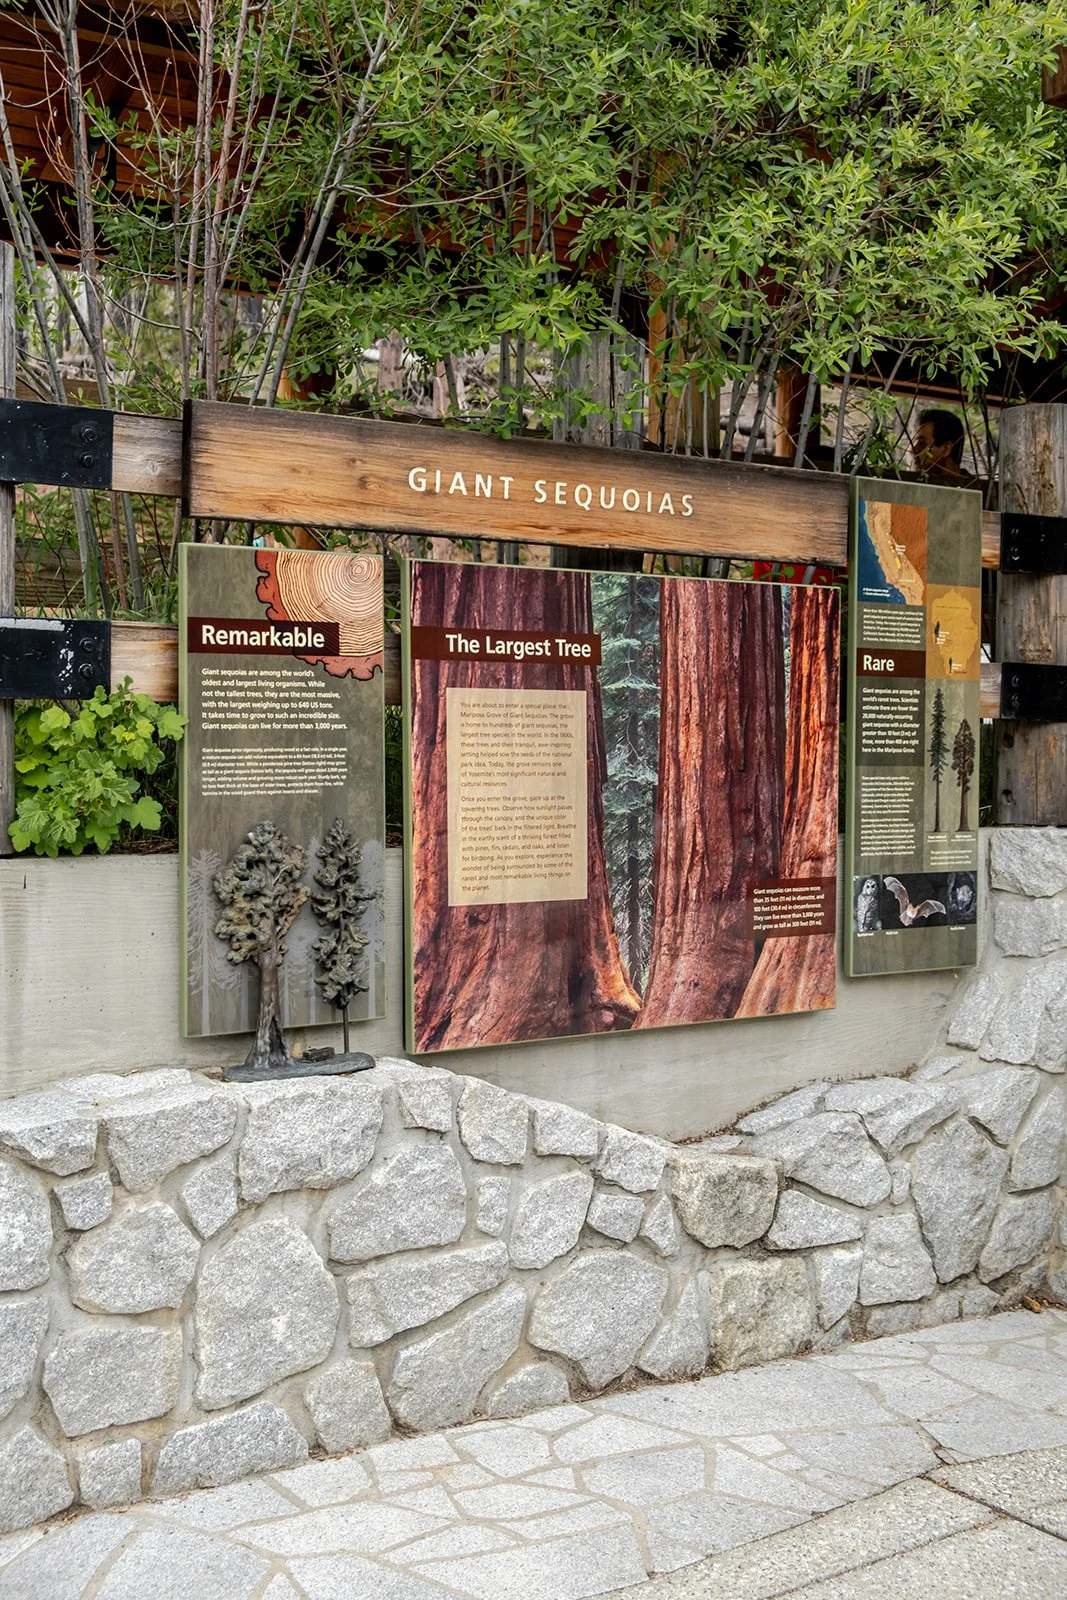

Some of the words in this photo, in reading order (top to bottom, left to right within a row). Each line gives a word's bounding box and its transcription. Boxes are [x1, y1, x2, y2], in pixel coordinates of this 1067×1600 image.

[408, 467, 514, 500] GIANT
[534, 480, 693, 517] SEQUOIAS
[201, 625, 325, 648] Remarkable
[446, 632, 480, 653] The
[486, 636, 552, 660] Largest
[555, 639, 592, 658] Tree
[862, 655, 895, 672] Rare
